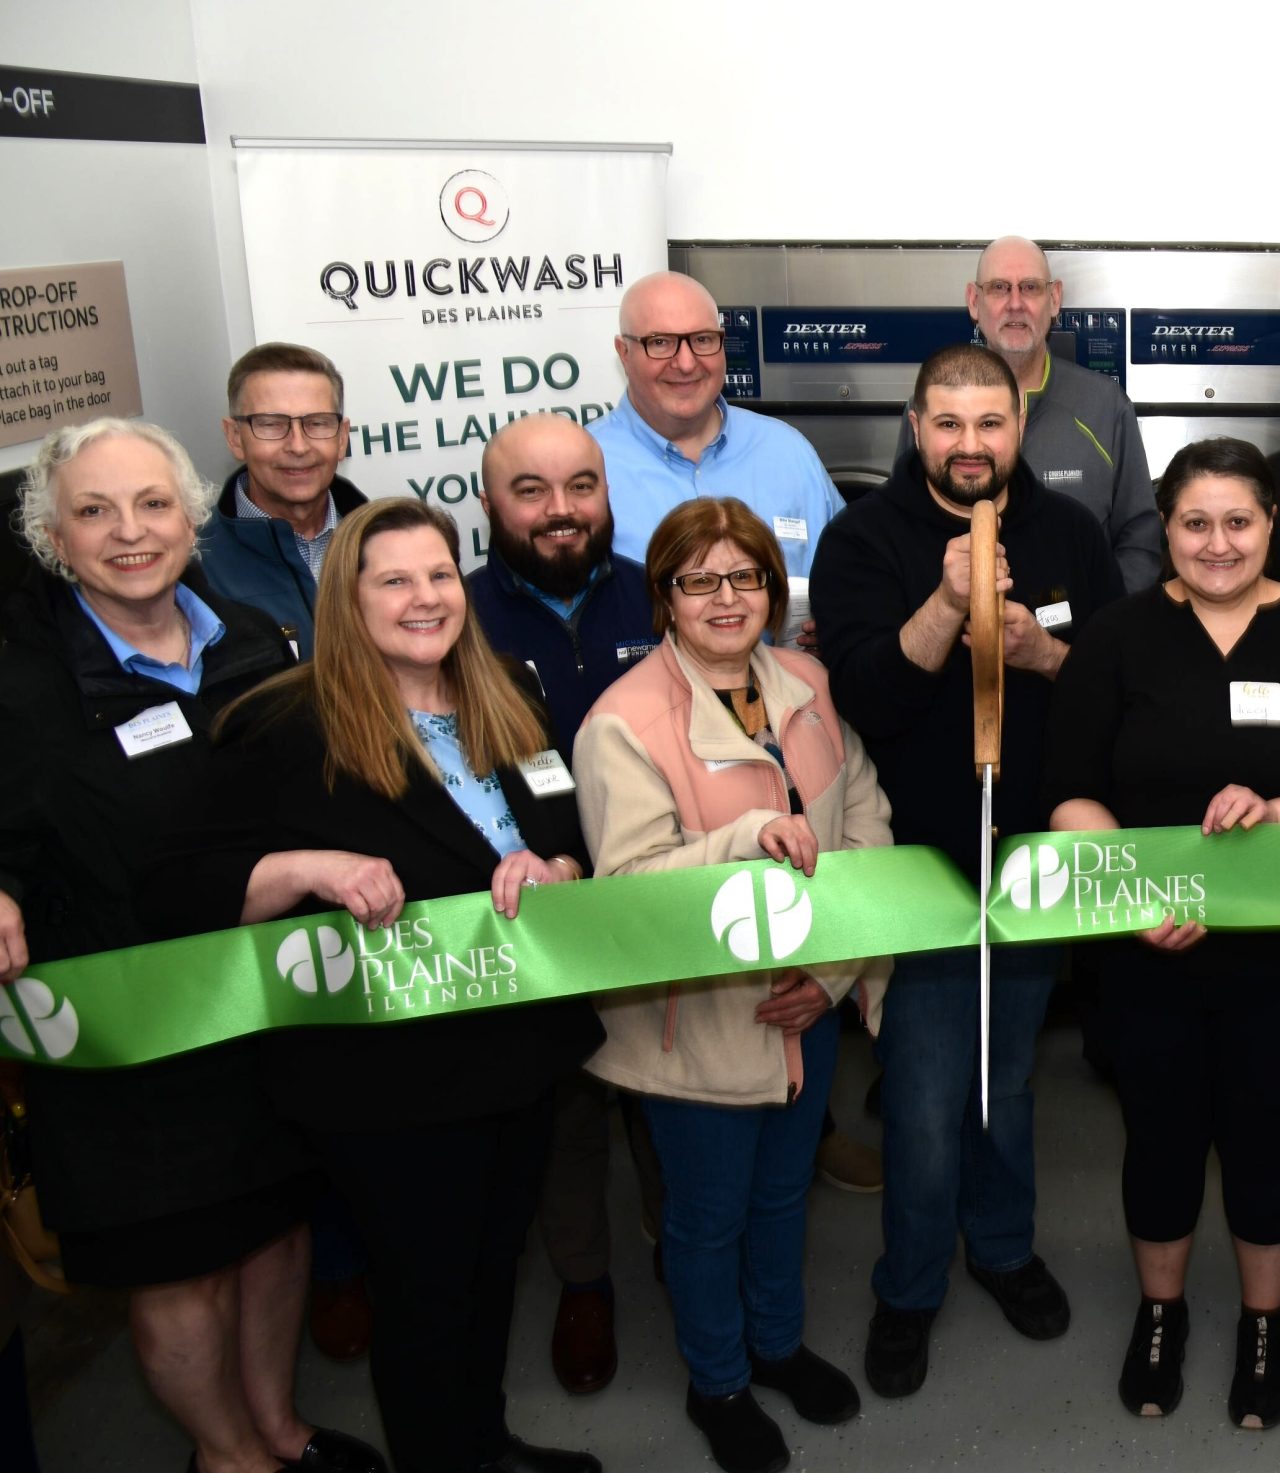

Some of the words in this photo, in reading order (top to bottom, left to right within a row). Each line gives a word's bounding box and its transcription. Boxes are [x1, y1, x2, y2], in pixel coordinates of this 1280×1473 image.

[0, 87, 54, 114] -OFF
[455, 186, 496, 226] Q
[0, 281, 78, 309] ROP-OFF
[320, 253, 624, 311] QUICKWASH
[0, 305, 99, 337] TRUCTIONS
[421, 307, 458, 325] DES
[465, 303, 543, 323] PLAINES
[784, 324, 867, 334] DEXTER
[784, 342, 830, 350] DRYER
[1152, 326, 1235, 336] DEXTER
[1151, 344, 1197, 352] DRYER
[6, 358, 26, 375] out
[29, 359, 36, 371] a
[38, 355, 58, 371] tag
[389, 358, 485, 403] WE
[502, 352, 580, 395] DO
[0, 381, 30, 401] ttach
[32, 379, 41, 394] it
[44, 378, 56, 392] to
[58, 374, 82, 393] your
[84, 370, 106, 386] bag
[0, 407, 26, 425] lace
[28, 403, 52, 420] bag
[53, 399, 64, 414] in
[66, 394, 85, 411] the
[87, 391, 111, 408] door
[1072, 842, 1136, 875] DES
[1073, 874, 1205, 909] PLAINES
[1077, 905, 1206, 927] ILLINOIS
[356, 917, 433, 957] DES
[360, 944, 517, 994] PLAINES
[367, 979, 519, 1013] ILLINOIS
